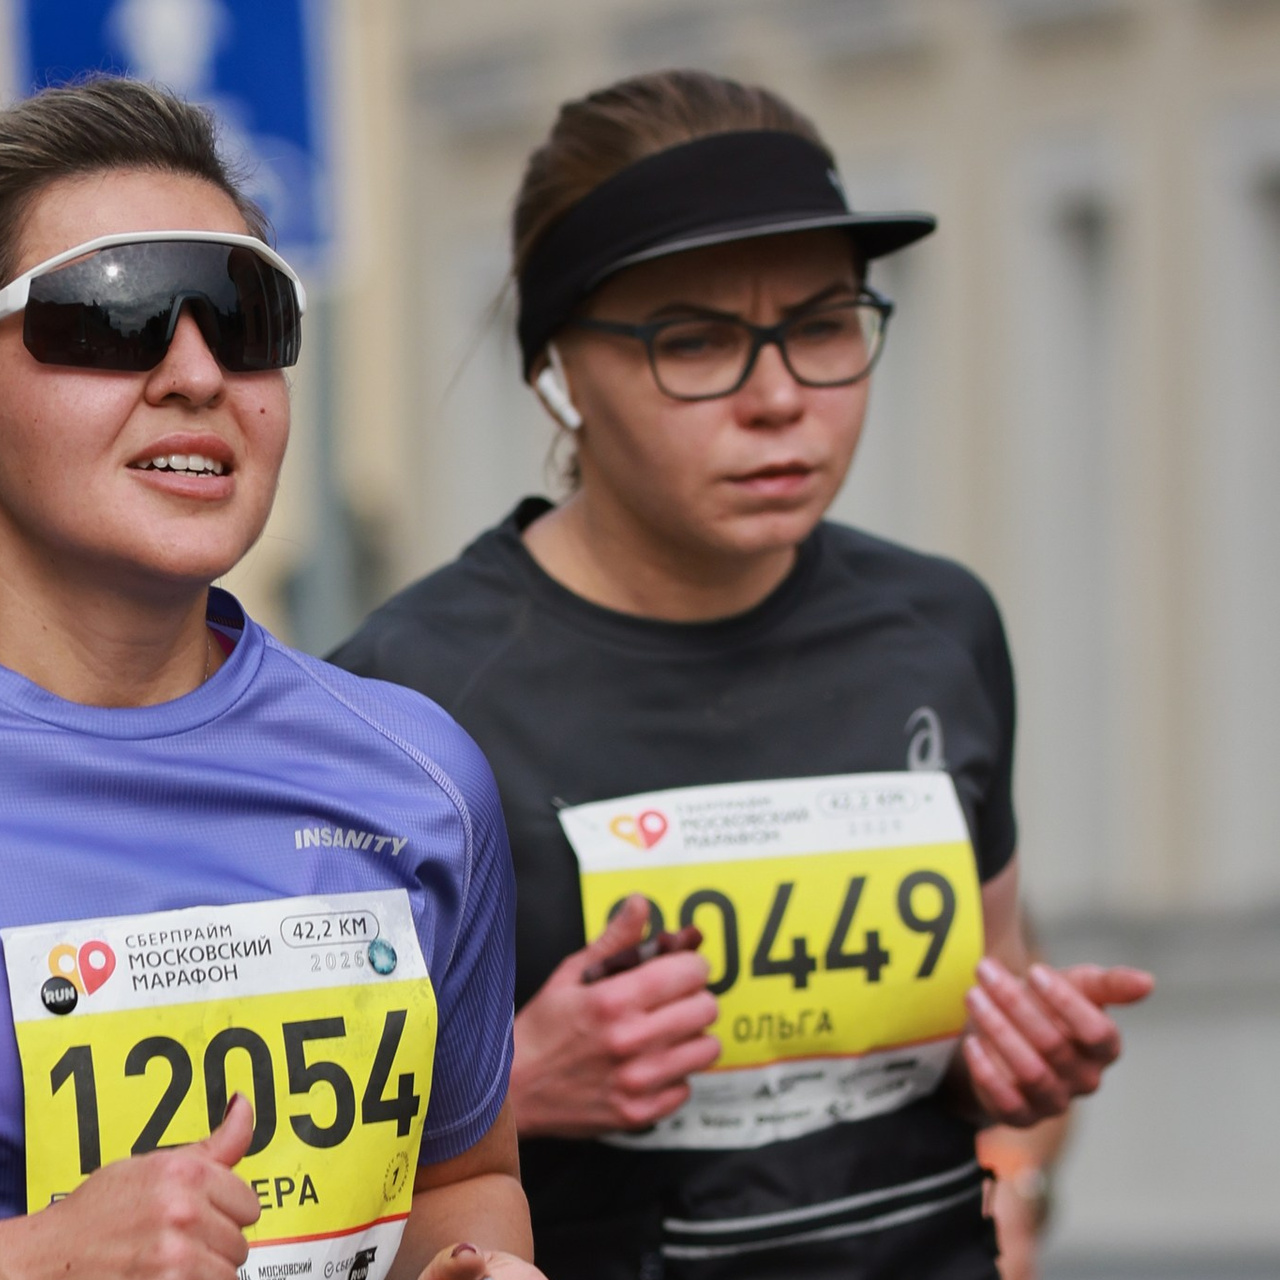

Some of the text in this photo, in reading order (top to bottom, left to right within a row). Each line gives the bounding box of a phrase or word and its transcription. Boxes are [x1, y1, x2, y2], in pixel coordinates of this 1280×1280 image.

[294, 827, 408, 856] INSANITY
[125, 922, 232, 948] СБЕРПРАЙМ
[293, 917, 367, 941] 42,2 КМ
[128, 935, 272, 970] МОСКОВСКИЙ
[132, 964, 238, 991] МАРАФОН
[45, 986, 75, 1004] RUN
[732, 1008, 833, 1044] ОЛЬГА
[50, 1010, 420, 1175] 12054
[251, 1174, 319, 1210] ЕРА
[258, 1258, 313, 1279] МОСКОВСКИЙ
